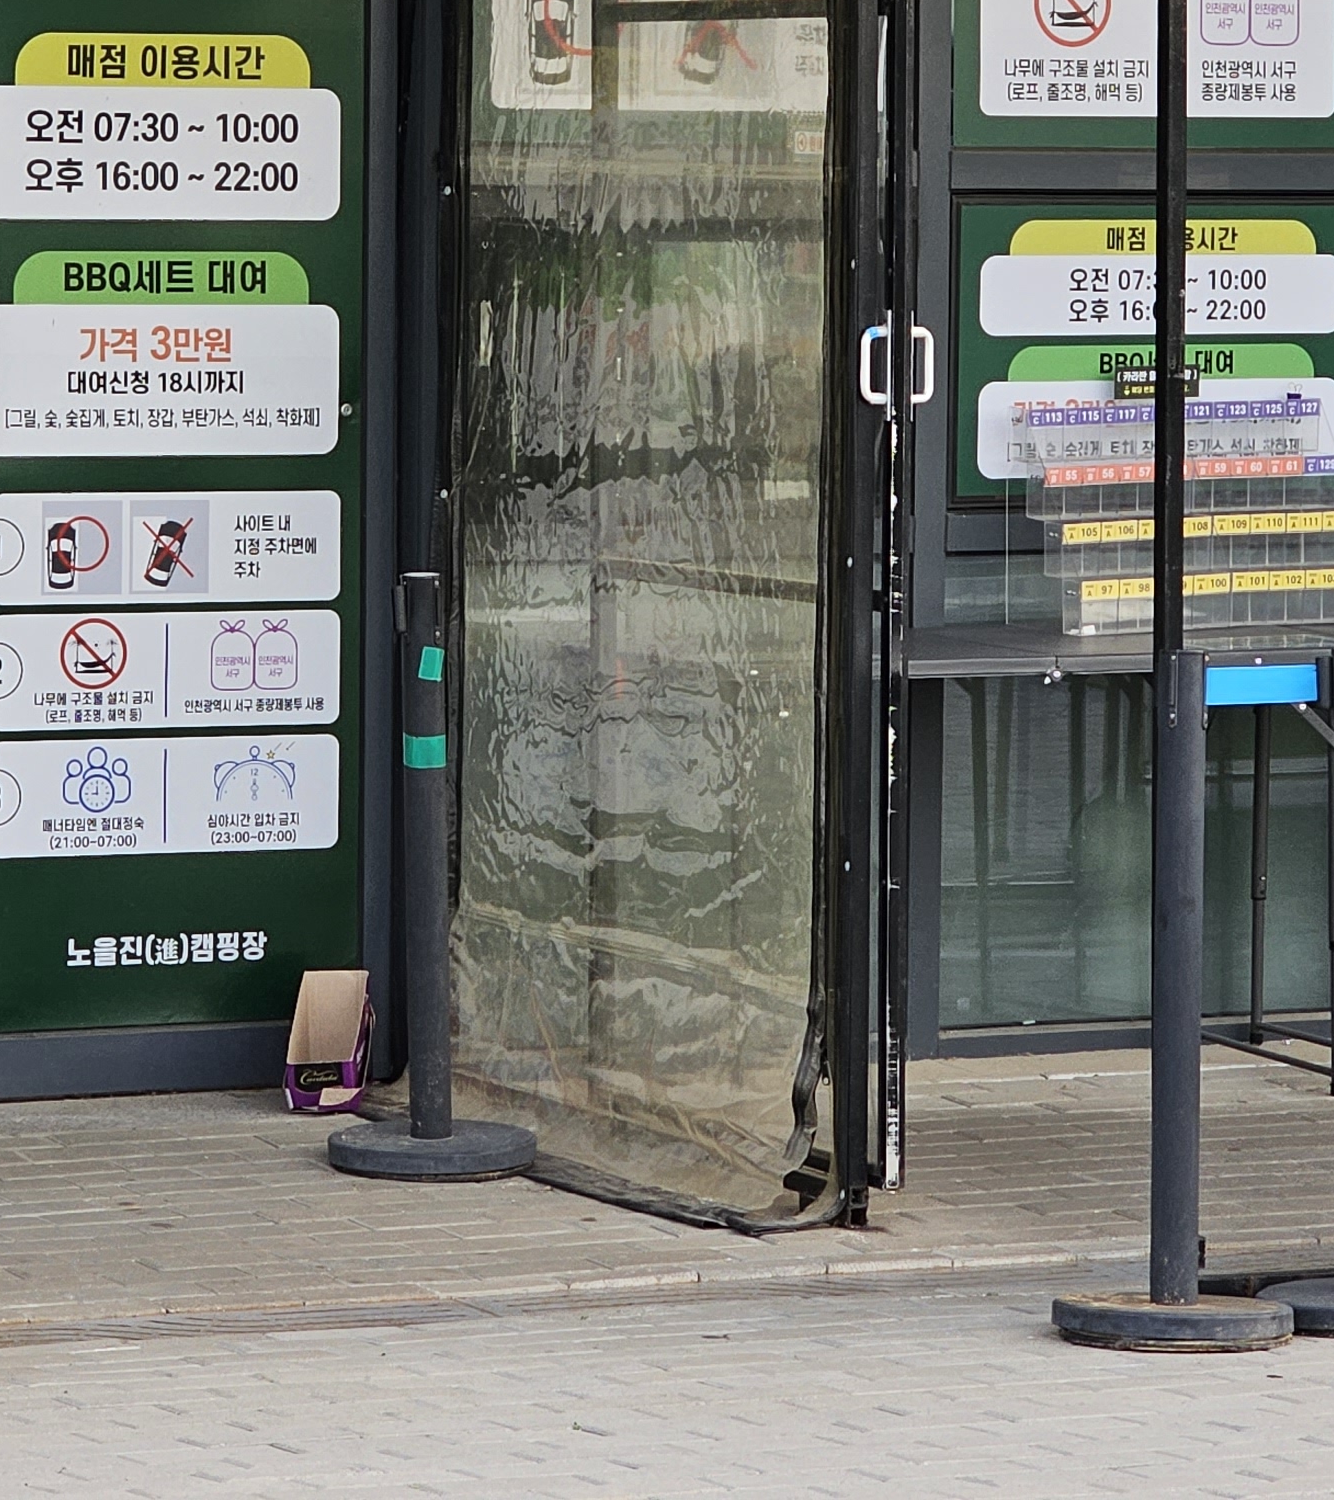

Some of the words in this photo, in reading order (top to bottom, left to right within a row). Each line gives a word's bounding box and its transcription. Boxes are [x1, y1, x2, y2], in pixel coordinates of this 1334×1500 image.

[1205, 1, 1246, 16] 인천광역시
[1254, 2, 1295, 17] 인천광역시
[1217, 17, 1234, 31] 서구
[1266, 18, 1283, 32] 서구
[67, 44, 127, 80] 매점
[141, 45, 266, 81] 이용시간
[1004, 58, 1045, 79] 나무에
[1048, 58, 1090, 79] 구조물
[1092, 58, 1119, 79] 설치
[1123, 59, 1150, 79] 금지
[1201, 60, 1267, 80] 인천광역시
[1270, 60, 1298, 80] 서구
[1007, 82, 1043, 104] (로프,
[1047, 82, 1091, 104] 줄조명,
[1095, 82, 1121, 102] 해먹
[1125, 82, 1144, 104] 등)
[1201, 83, 1266, 103] 종량제봉투
[1270, 83, 1297, 102] 사용
[25, 109, 84, 145] 오전
[93, 112, 179, 143] 07:30
[215, 113, 299, 144] 10:00
[25, 157, 84, 194] 오후
[95, 161, 179, 192] 16:00
[213, 162, 299, 192] 22:00
[1106, 226, 1147, 252] 매점
[63, 259, 194, 295] BBQ세트
[208, 259, 267, 295] 대여
[1069, 268, 1110, 294] 오전
[1208, 269, 1267, 291] 10:00
[1069, 298, 1110, 324] 오후
[1206, 299, 1267, 321] 22:00
[78, 326, 138, 363] 가격
[149, 325, 233, 363] 3만원
[1195, 349, 1234, 375] 대여
[67, 370, 149, 395] 대여신청
[157, 370, 245, 395] 18시까지
[5, 408, 41, 431] [그릴,
[45, 408, 61, 431] 숯,
[65, 408, 109, 431] 숯집게,
[113, 408, 144, 431] 토치,
[147, 408, 175, 431] 장갑,
[181, 408, 238, 431] 부탄가스,
[242, 408, 272, 431] 석쇠,
[276, 408, 321, 431] 착화제]
[1044, 411, 1063, 424] 113
[1081, 409, 1100, 422] 115
[1117, 408, 1137, 421] 117
[1229, 403, 1247, 416] 123
[1300, 401, 1318, 413] 127
[1137, 465, 1152, 478] 57
[234, 513, 275, 534] 사이트
[277, 513, 291, 534] 내
[1080, 527, 1099, 538] 105
[1118, 524, 1135, 536] 106
[1266, 517, 1283, 528] 110
[1302, 516, 1319, 527] 111
[233, 537, 261, 556] 지정
[264, 537, 317, 556] 주차면에
[233, 560, 261, 580] 주차
[1100, 584, 1114, 595] 97
[1137, 582, 1152, 593] 98
[1210, 577, 1227, 589] 100
[1248, 575, 1266, 587] 101
[1285, 574, 1303, 585] 102
[33, 692, 68, 708] 나무에
[70, 691, 103, 707] 구조물
[106, 690, 128, 706] 설치
[131, 690, 154, 706] 금지
[184, 698, 232, 714] 인천광역시
[234, 697, 255, 713] 서구
[305, 696, 325, 712] 사용
[45, 707, 72, 724] (로프,
[42, 817, 98, 833] 매너타임엔
[100, 816, 145, 832] 절대정숙
[207, 813, 252, 828] 심야시간
[254, 812, 276, 828] 입차
[278, 811, 301, 827] 금지
[49, 833, 138, 851] (21:00~07:00)
[210, 828, 298, 846] (23:00~07:00)
